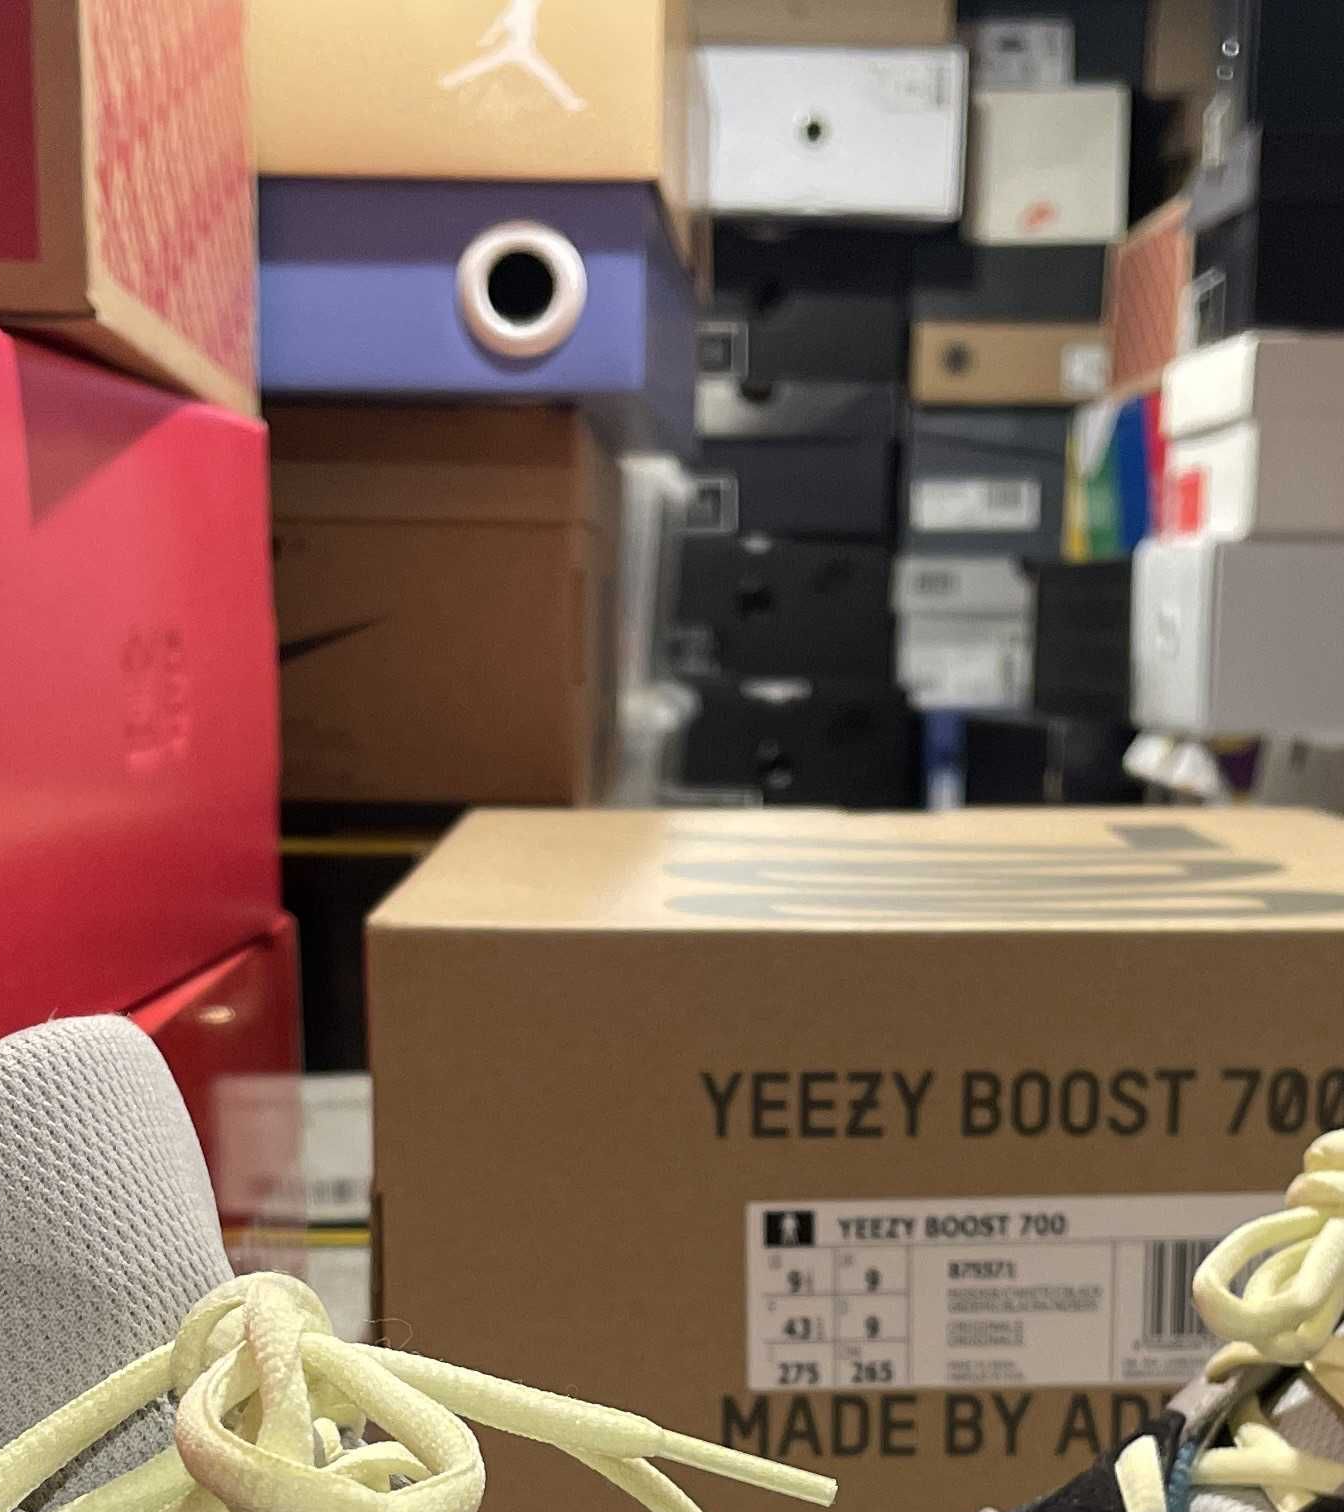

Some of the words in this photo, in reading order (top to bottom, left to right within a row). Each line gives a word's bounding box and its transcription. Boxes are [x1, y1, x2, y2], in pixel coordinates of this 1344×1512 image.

[700, 1070, 935, 1140] YEEZY
[959, 1068, 1197, 1138] BOOST
[838, 1216, 914, 1240] YEEZY
[924, 1214, 1010, 1239] BOOST
[1019, 1212, 1068, 1238] 700
[777, 1361, 821, 1386] 275
[851, 1359, 894, 1384] 265
[722, 1393, 917, 1458] MADE
[944, 1393, 1034, 1457] BY
